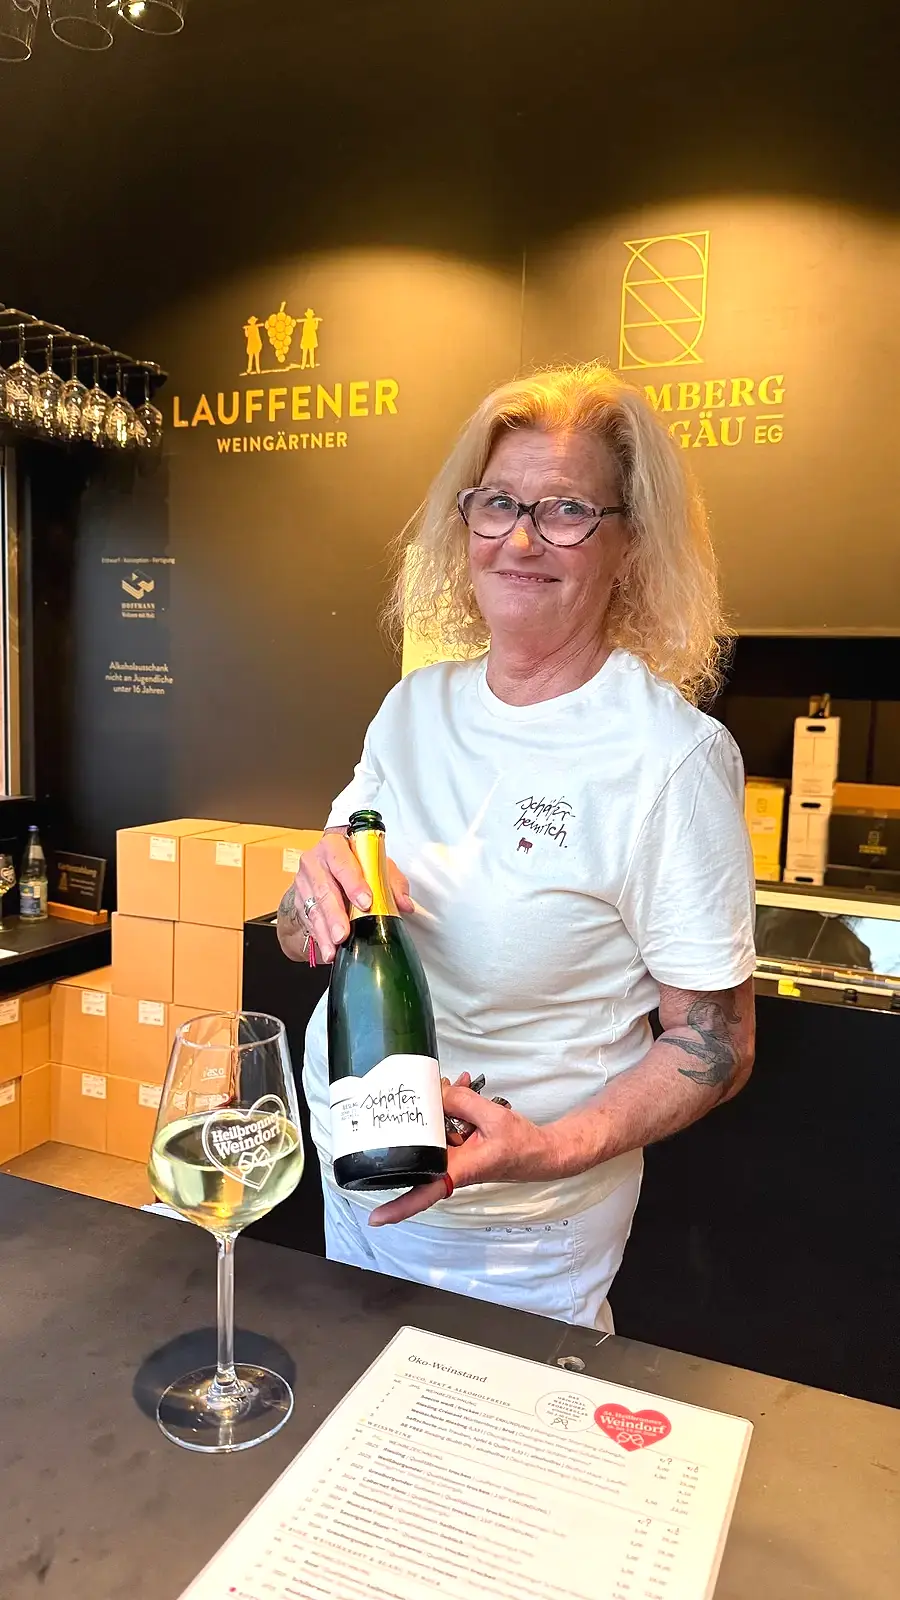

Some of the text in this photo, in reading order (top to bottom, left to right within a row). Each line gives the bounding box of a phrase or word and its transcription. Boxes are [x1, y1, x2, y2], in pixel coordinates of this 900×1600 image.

[173, 378, 399, 428] LAUFFENER
[217, 430, 348, 453] WEINGÄRTNER
[754, 424, 783, 444] EG
[109, 661, 169, 673] Alkoholausschank
[105, 673, 123, 682] nicht
[133, 674, 174, 686] Jugendliche
[133, 685, 141, 694] 16
[142, 685, 165, 695] Jahren
[211, 1109, 280, 1144] Heilbronner
[213, 1122, 281, 1160] Weindorf
[407, 1354, 488, 1382] Öko-Weinstand
[600, 1415, 667, 1435] Weindorf
